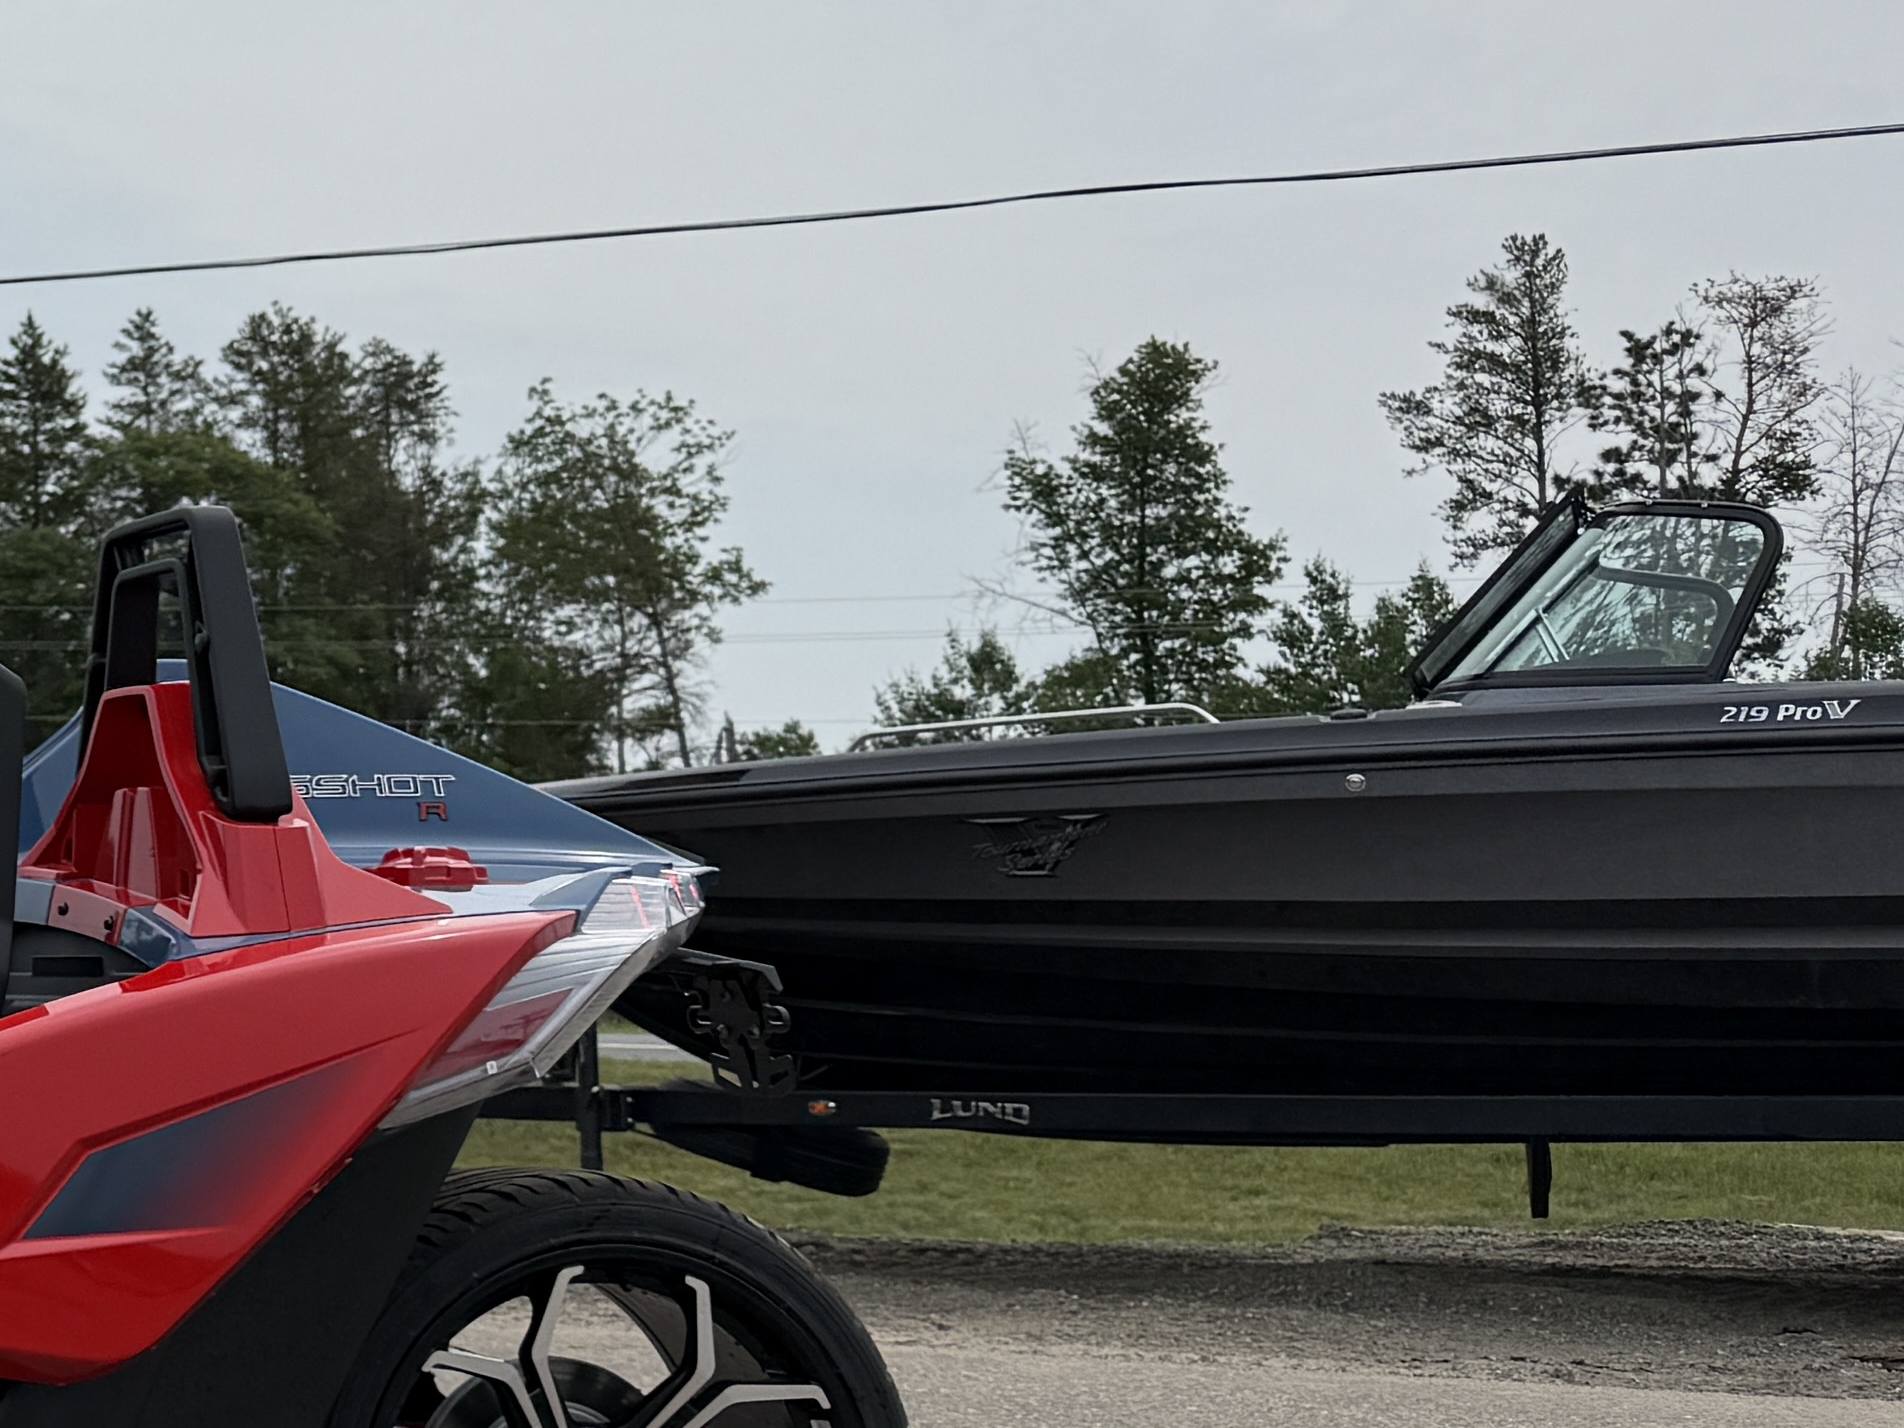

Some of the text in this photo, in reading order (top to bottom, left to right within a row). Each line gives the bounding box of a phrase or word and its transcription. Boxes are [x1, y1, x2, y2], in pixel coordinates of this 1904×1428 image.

[1720, 706, 1769, 723] 219
[417, 801, 449, 822] R
[930, 1098, 1030, 1125] LUND
